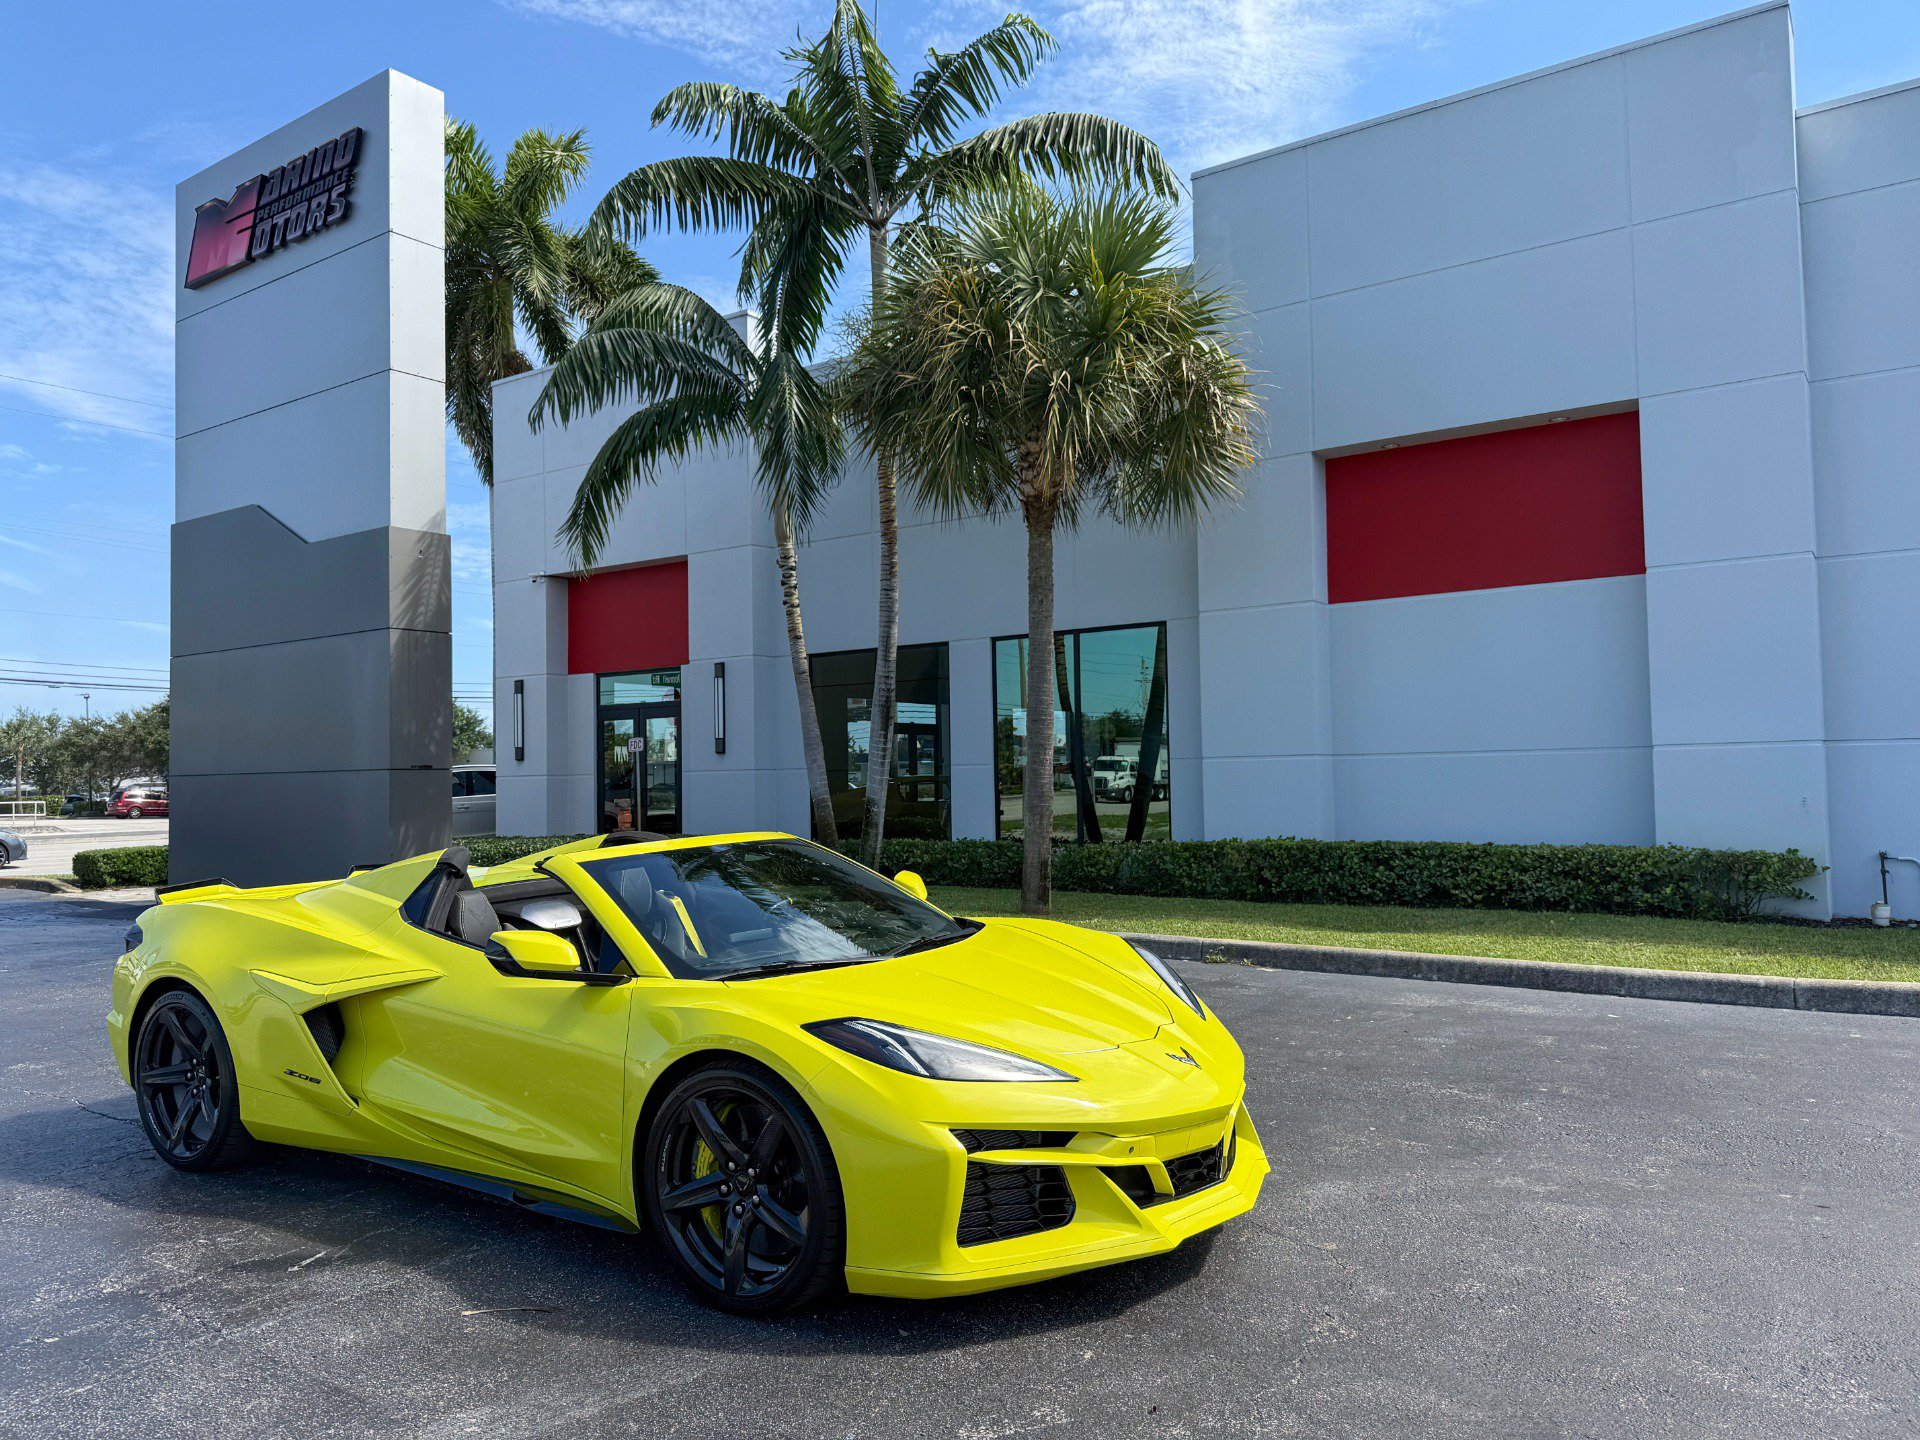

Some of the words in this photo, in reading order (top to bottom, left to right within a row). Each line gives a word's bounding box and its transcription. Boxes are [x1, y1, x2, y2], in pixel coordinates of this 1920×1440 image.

[256, 168, 351, 223] PERFORMANCE
[629, 739, 642, 749] FDC
[283, 1068, 322, 1085] Z06
